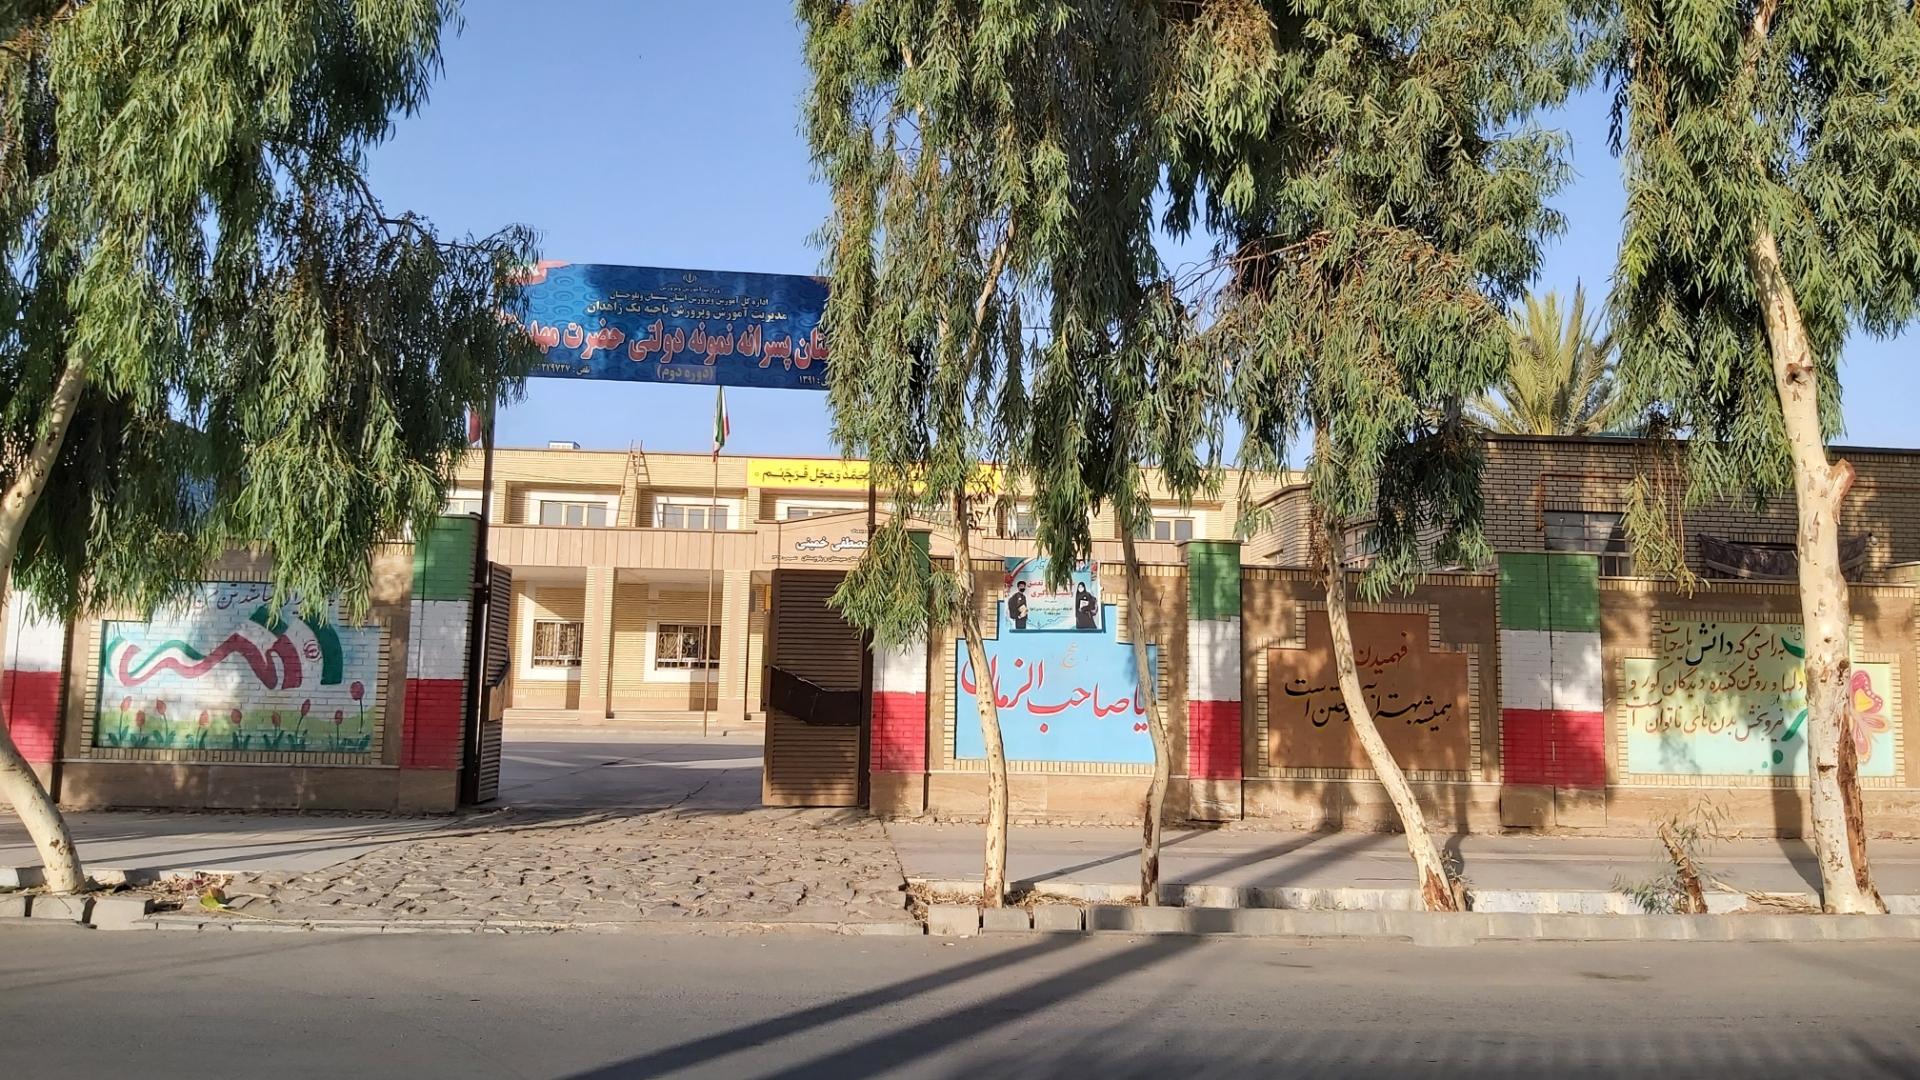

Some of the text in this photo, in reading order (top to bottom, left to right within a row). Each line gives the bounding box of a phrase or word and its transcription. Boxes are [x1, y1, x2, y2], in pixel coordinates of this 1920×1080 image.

[587, 300, 623, 314] زاهدان
[625, 303, 640, 313] یک
[644, 303, 669, 315] ناحیه
[713, 307, 748, 320] آموزش
[741, 297, 751, 306] کل
[751, 310, 788, 322] مدیریت
[563, 317, 626, 360] حضرت
[628, 318, 684, 363] دولتی
[688, 322, 734, 366] نمونه
[737, 323, 792, 371] پسرانه
[795, 535, 830, 551] خمینی
[1355, 631, 1408, 674] فهمیدن
[1685, 622, 1734, 667] دانش
[1734, 625, 1758, 655] که
[1746, 632, 1778, 661] راستی
[1641, 661, 1674, 693] کور
[1661, 667, 1705, 699] دیدگان
[1709, 661, 1746, 695] کننده
[1736, 663, 1767, 692] روشن
[1027, 682, 1130, 734] صاحب
[1413, 695, 1453, 731] همیشه
